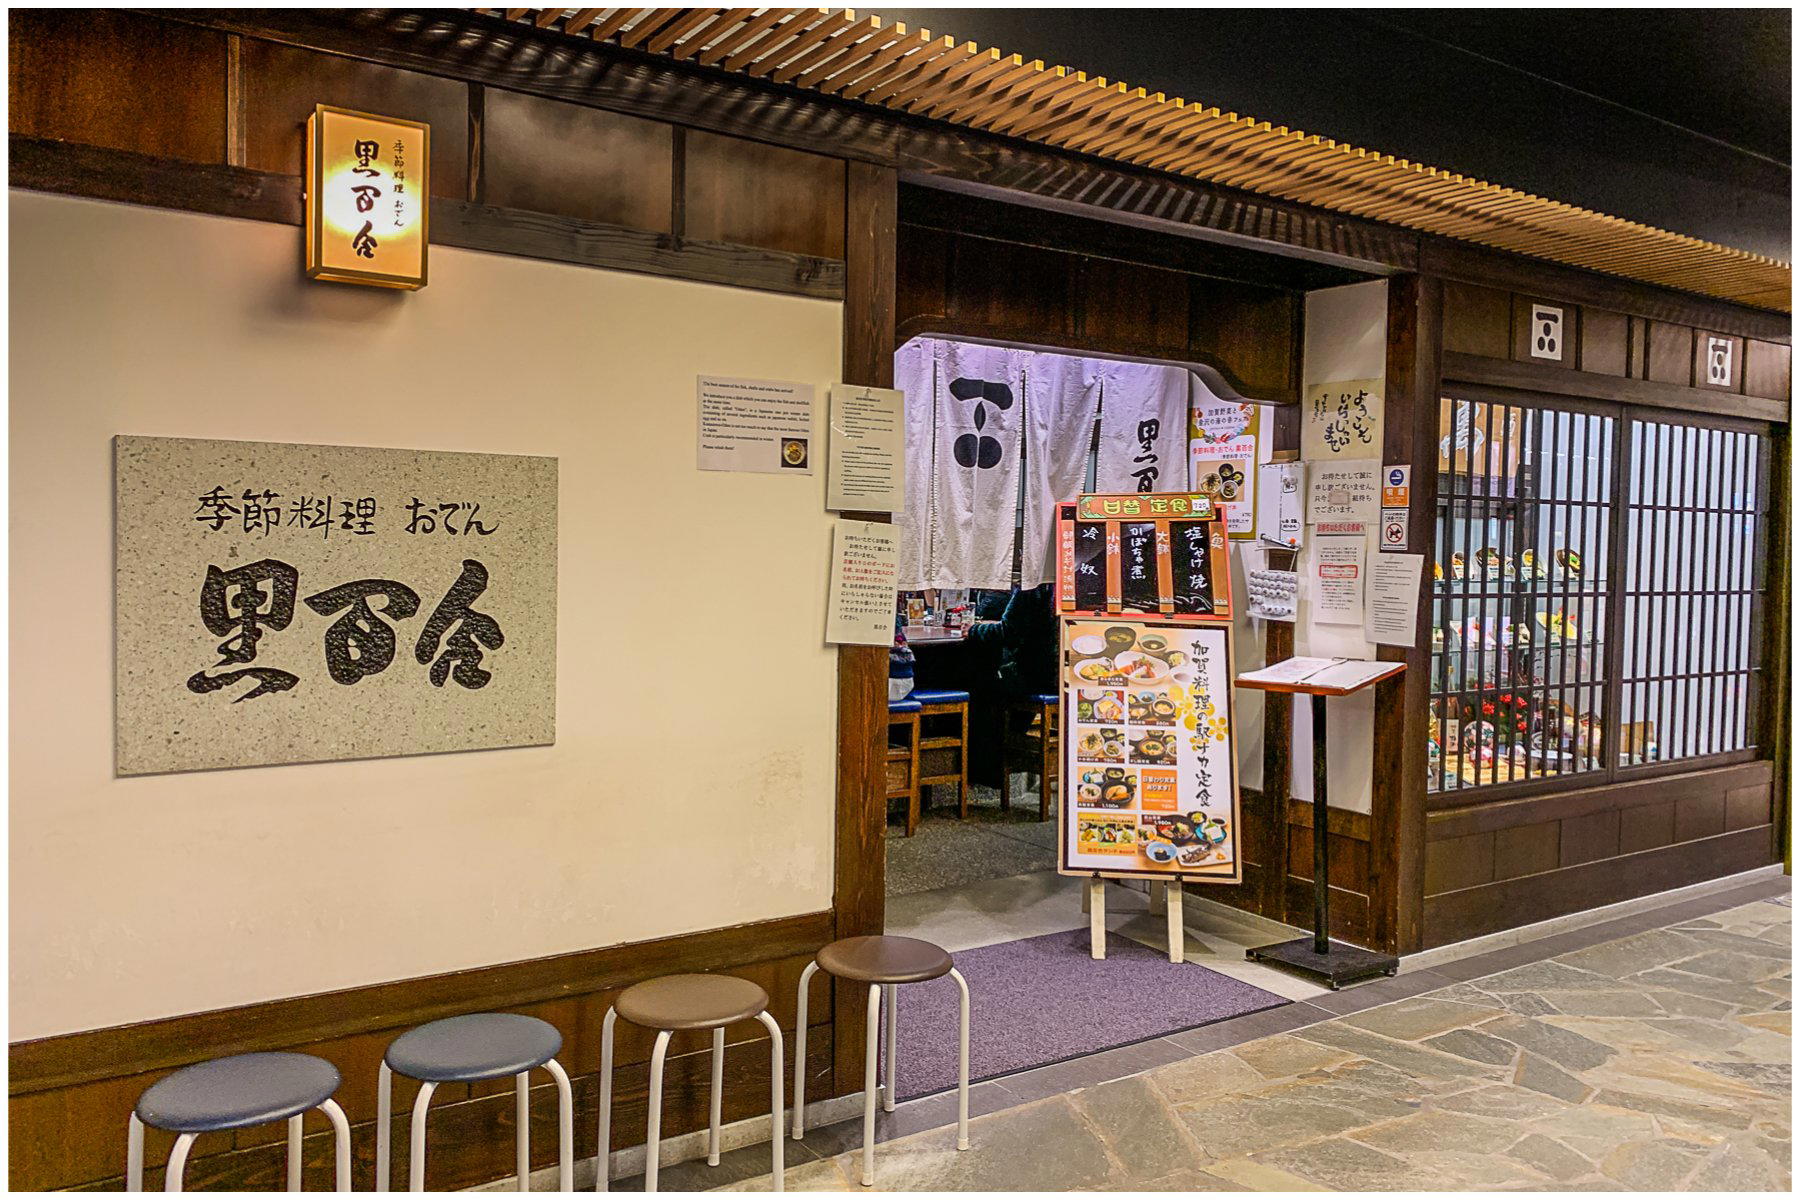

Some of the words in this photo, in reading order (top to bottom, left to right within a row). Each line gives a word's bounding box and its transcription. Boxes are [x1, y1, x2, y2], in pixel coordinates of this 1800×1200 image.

[392, 140, 405, 194] 季節料理
[394, 200, 405, 227] おでん
[1353, 390, 1372, 444] ようこそ
[1315, 482, 1376, 492] 申し訳ございません。
[1321, 472, 1372, 480] お待たせして誠に
[195, 485, 376, 539] 季節料理
[404, 498, 500, 536] おでん
[1104, 500, 1140, 514] 日替
[1150, 498, 1188, 513] 定食
[1314, 506, 1355, 514] でございます。
[1080, 526, 1100, 576] 冷奴
[1106, 532, 1120, 556] 小鉢
[1130, 528, 1147, 580] かぼちゃ煮
[1184, 526, 1208, 590] 塩しゃけ焼
[1210, 532, 1224, 550] 魚
[186, 558, 505, 704] 黒百合
[1191, 640, 1212, 808] 加賀料理の駅ナカ定食
